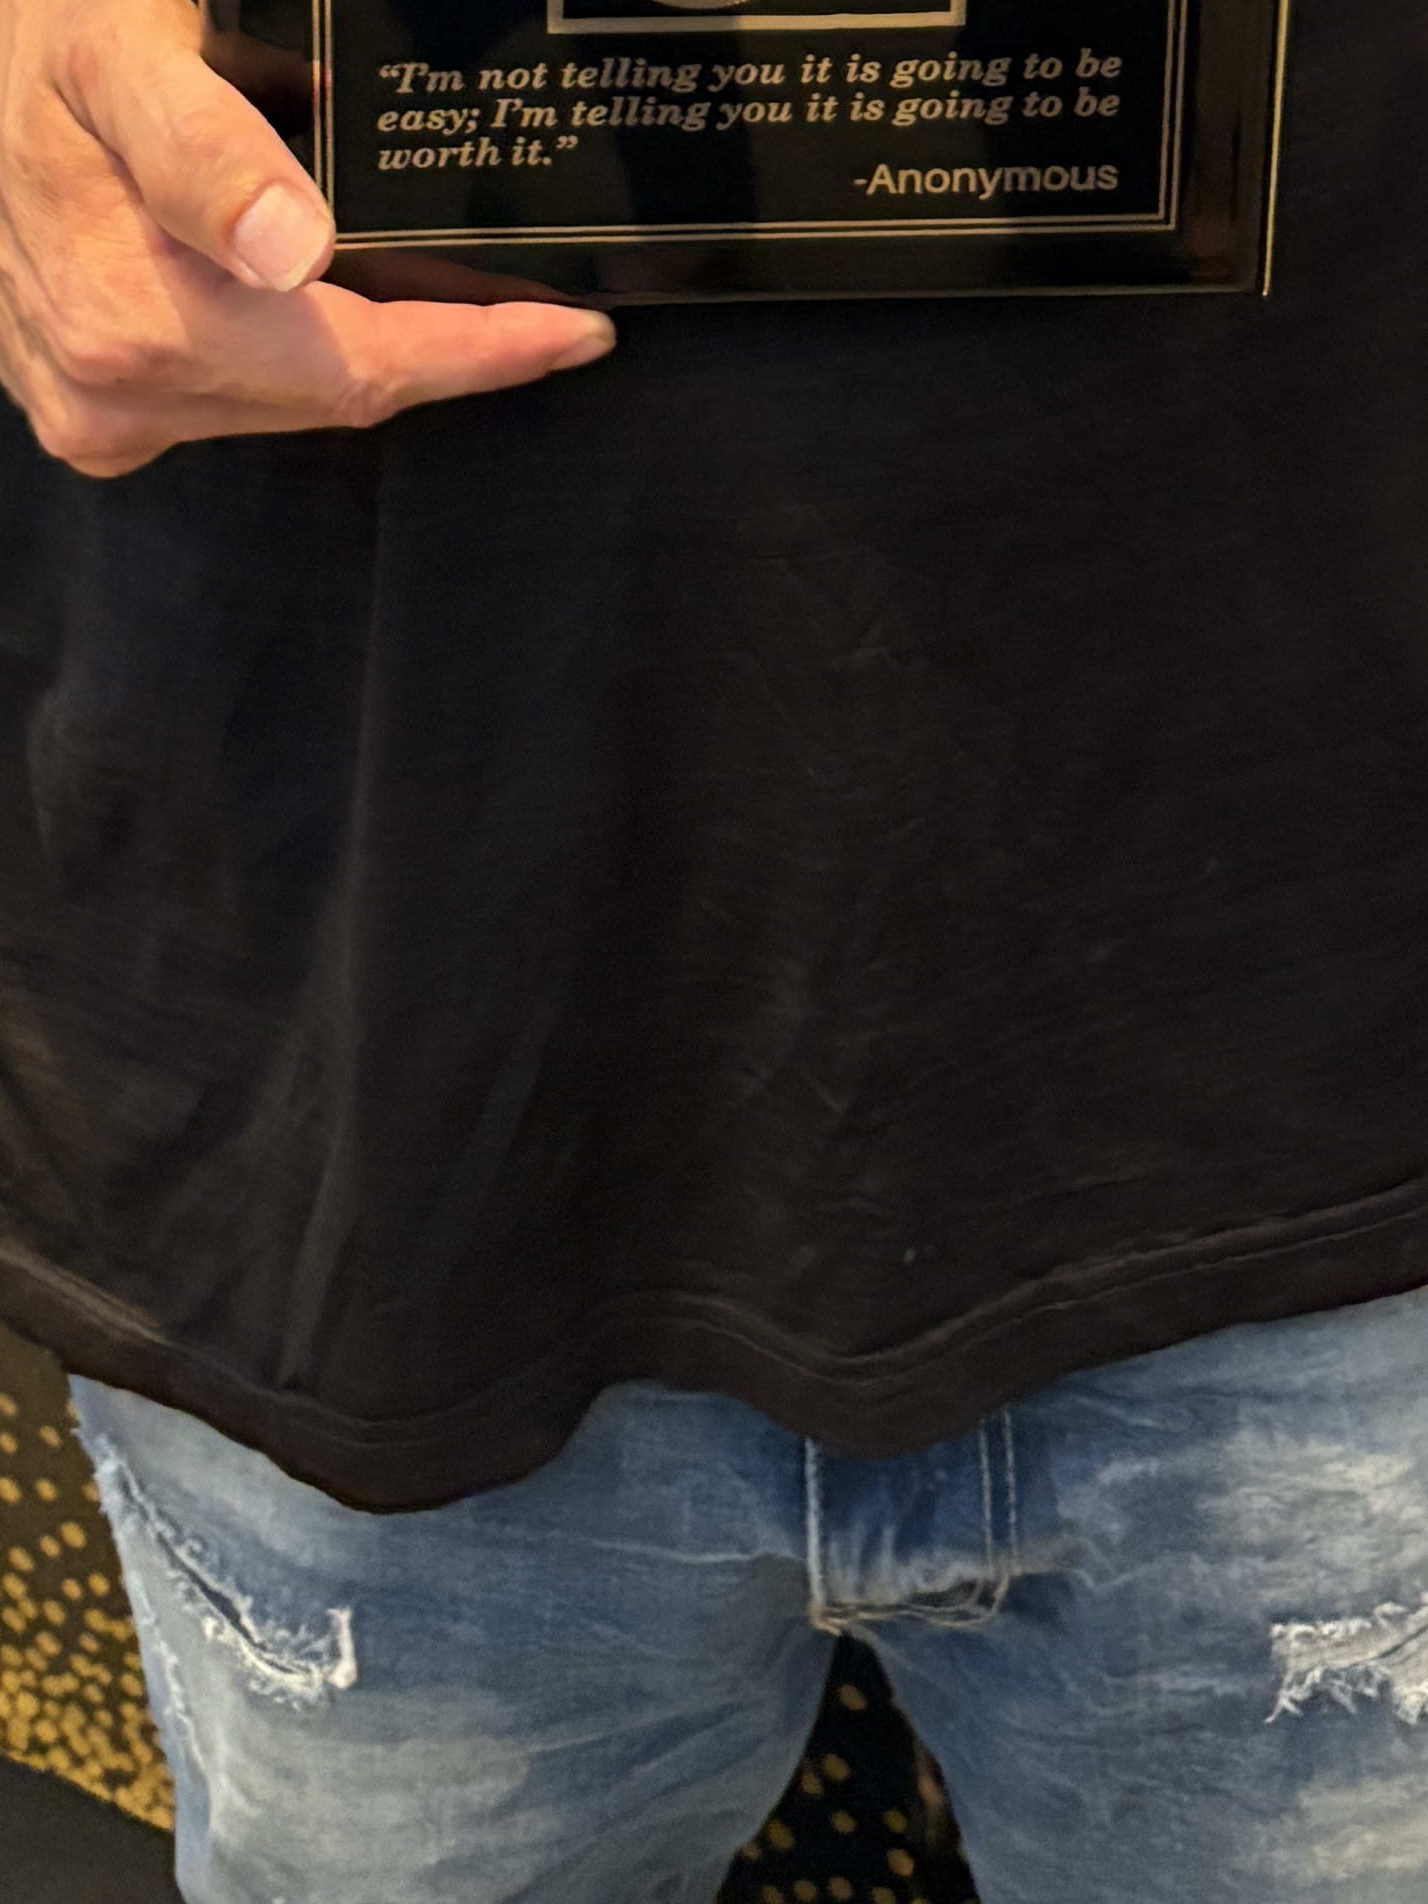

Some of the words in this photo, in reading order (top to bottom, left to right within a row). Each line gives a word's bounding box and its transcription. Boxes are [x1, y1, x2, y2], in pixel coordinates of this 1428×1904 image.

[477, 61, 550, 92] not
[560, 55, 702, 93] telling
[707, 61, 786, 93] you
[799, 53, 833, 85] it
[845, 52, 882, 84] is
[888, 50, 1014, 90] going
[1022, 52, 1064, 80] to
[1074, 47, 1123, 79] be
[376, 106, 481, 137] easy;
[570, 95, 711, 133] telling
[715, 101, 794, 131] you
[805, 92, 838, 124] it
[848, 91, 886, 122] is
[890, 88, 1015, 128] going
[1022, 90, 1064, 119] to
[1073, 85, 1122, 118] be
[377, 135, 503, 171] worth
[852, 162, 1121, 201] -Anonymous
